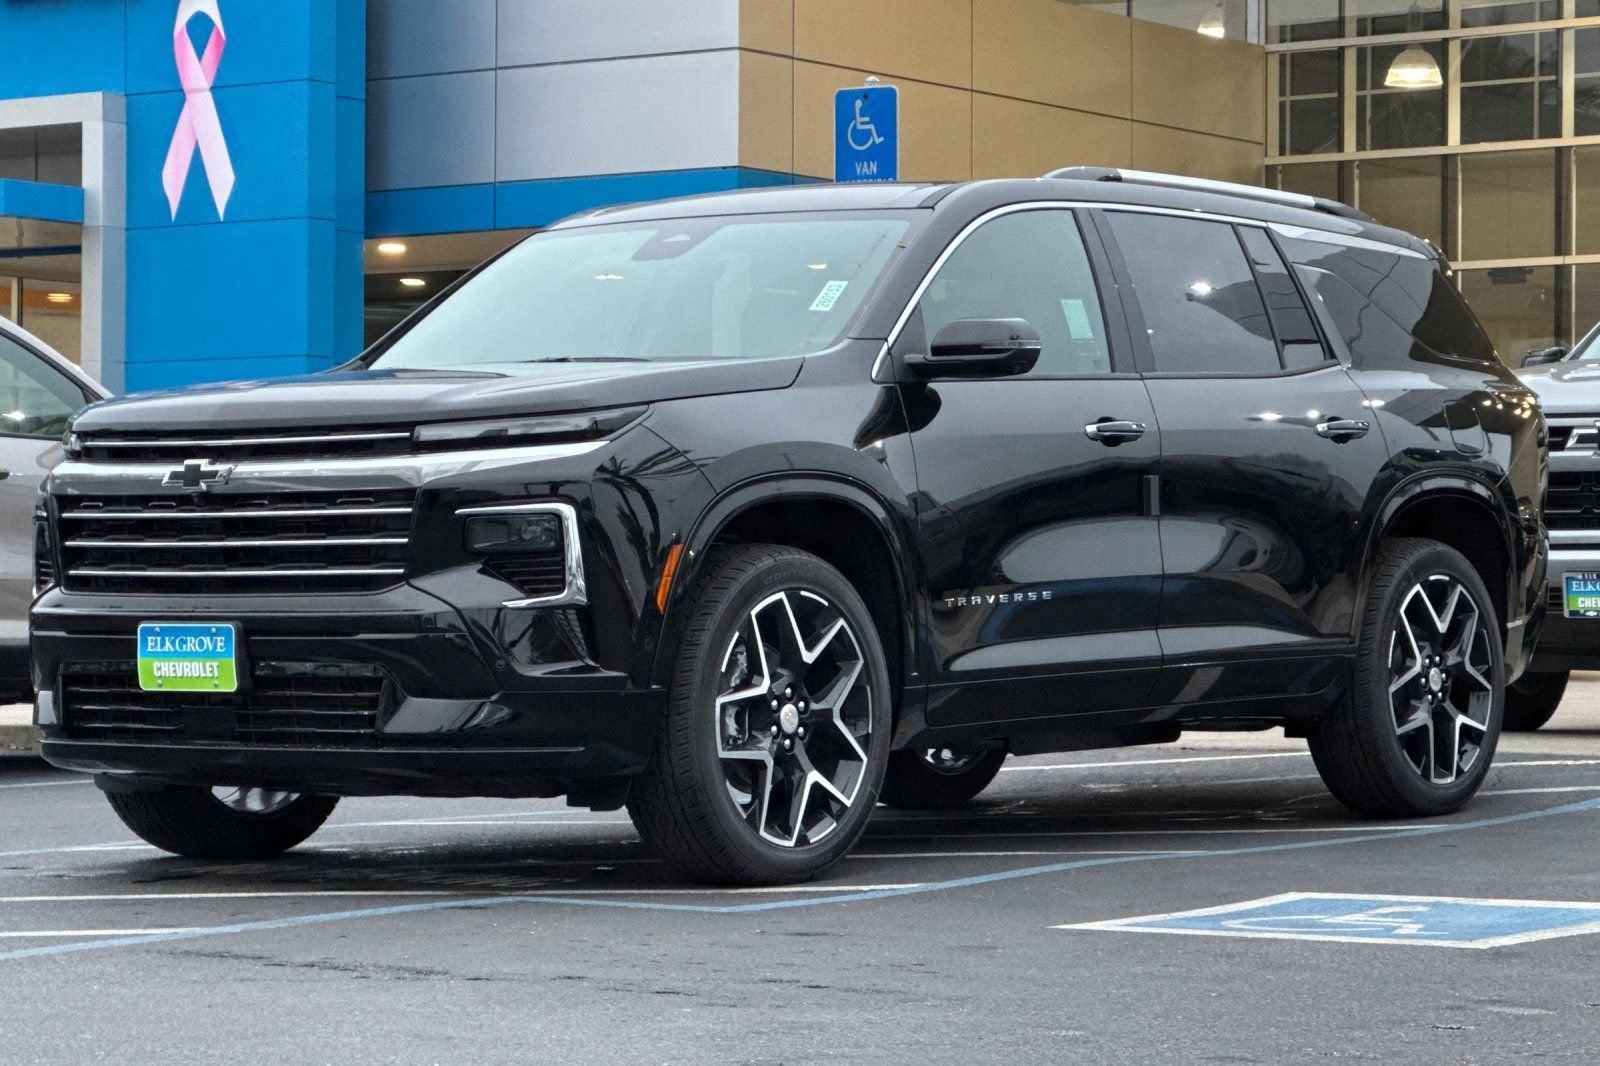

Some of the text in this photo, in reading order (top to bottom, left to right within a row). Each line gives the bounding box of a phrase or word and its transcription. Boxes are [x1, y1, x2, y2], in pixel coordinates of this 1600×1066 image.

[855, 161, 877, 176] VAN
[945, 591, 1052, 607] TRAVERSE
[153, 661, 219, 678] CHEVROLET
